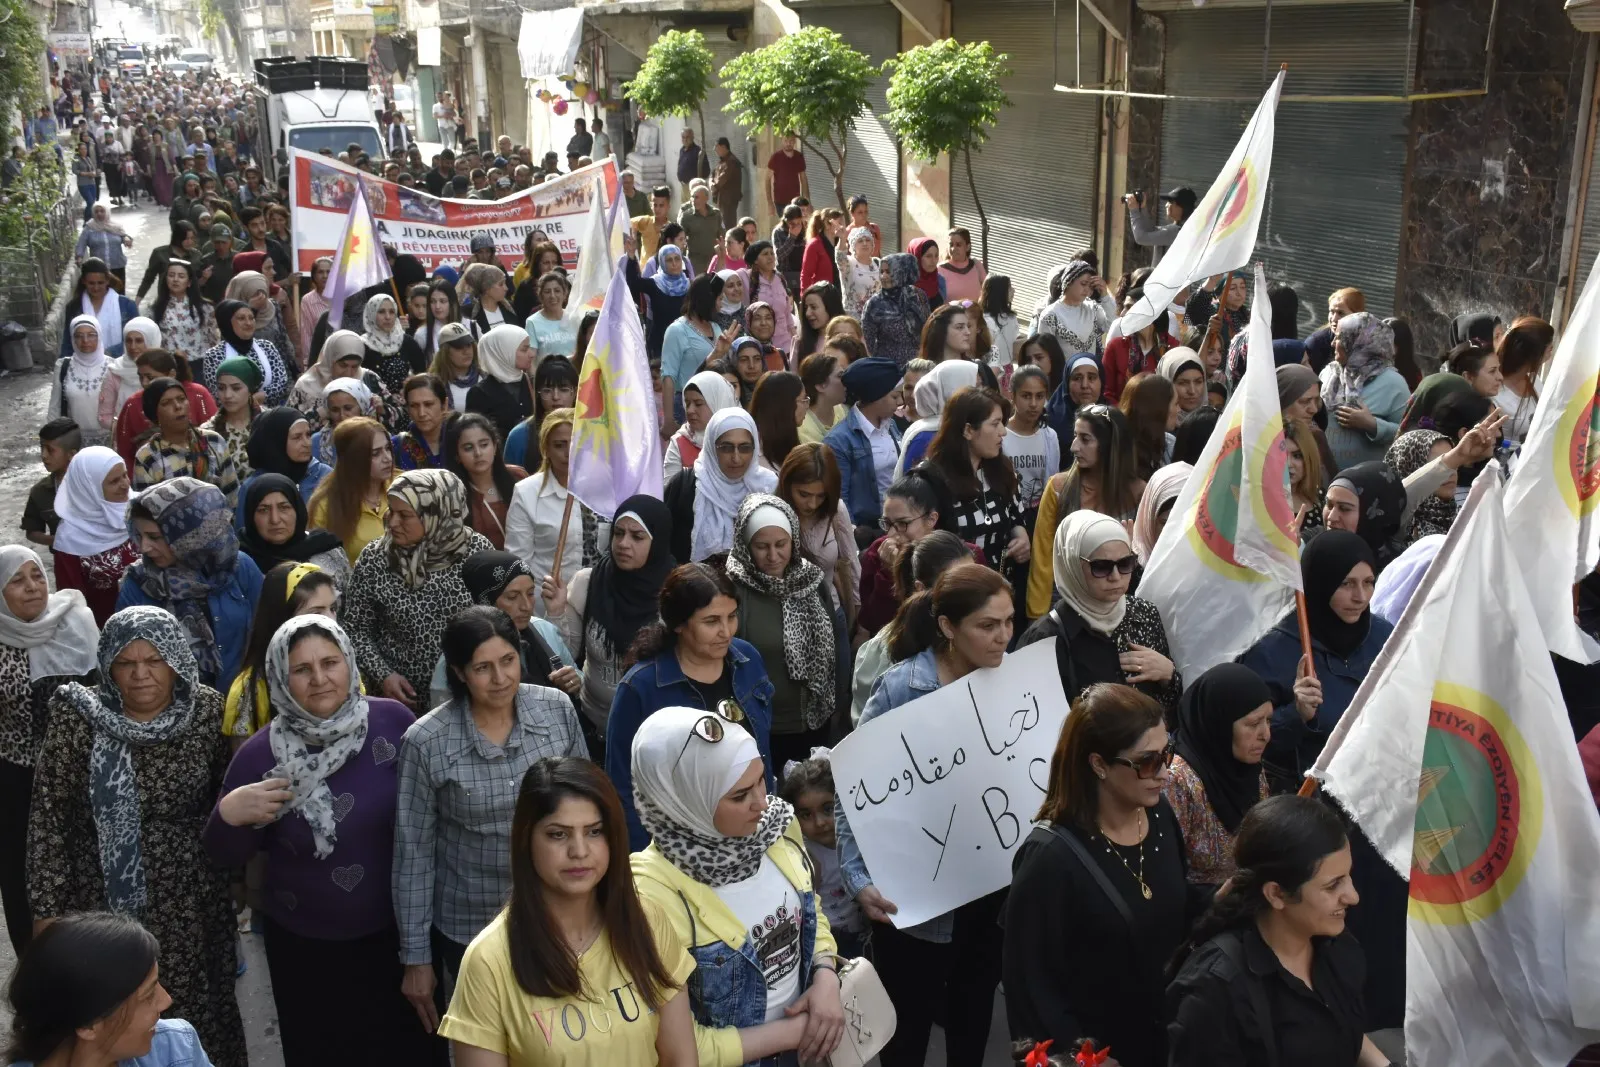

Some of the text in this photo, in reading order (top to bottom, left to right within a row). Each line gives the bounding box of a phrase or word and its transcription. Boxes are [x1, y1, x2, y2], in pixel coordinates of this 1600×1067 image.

[402, 226, 412, 237] JI
[416, 227, 509, 240] DAGIRKEIYA
[546, 222, 563, 233] RE
[402, 240, 470, 253] RÊVEBERI
[560, 239, 577, 250] RE
[1009, 455, 1047, 469] OSCHIN
[849, 679, 1040, 811] تحيا مقاومة
[760, 925, 797, 956] OTEL
[764, 949, 791, 968] VACANCY
[532, 982, 656, 1047] VOGU
